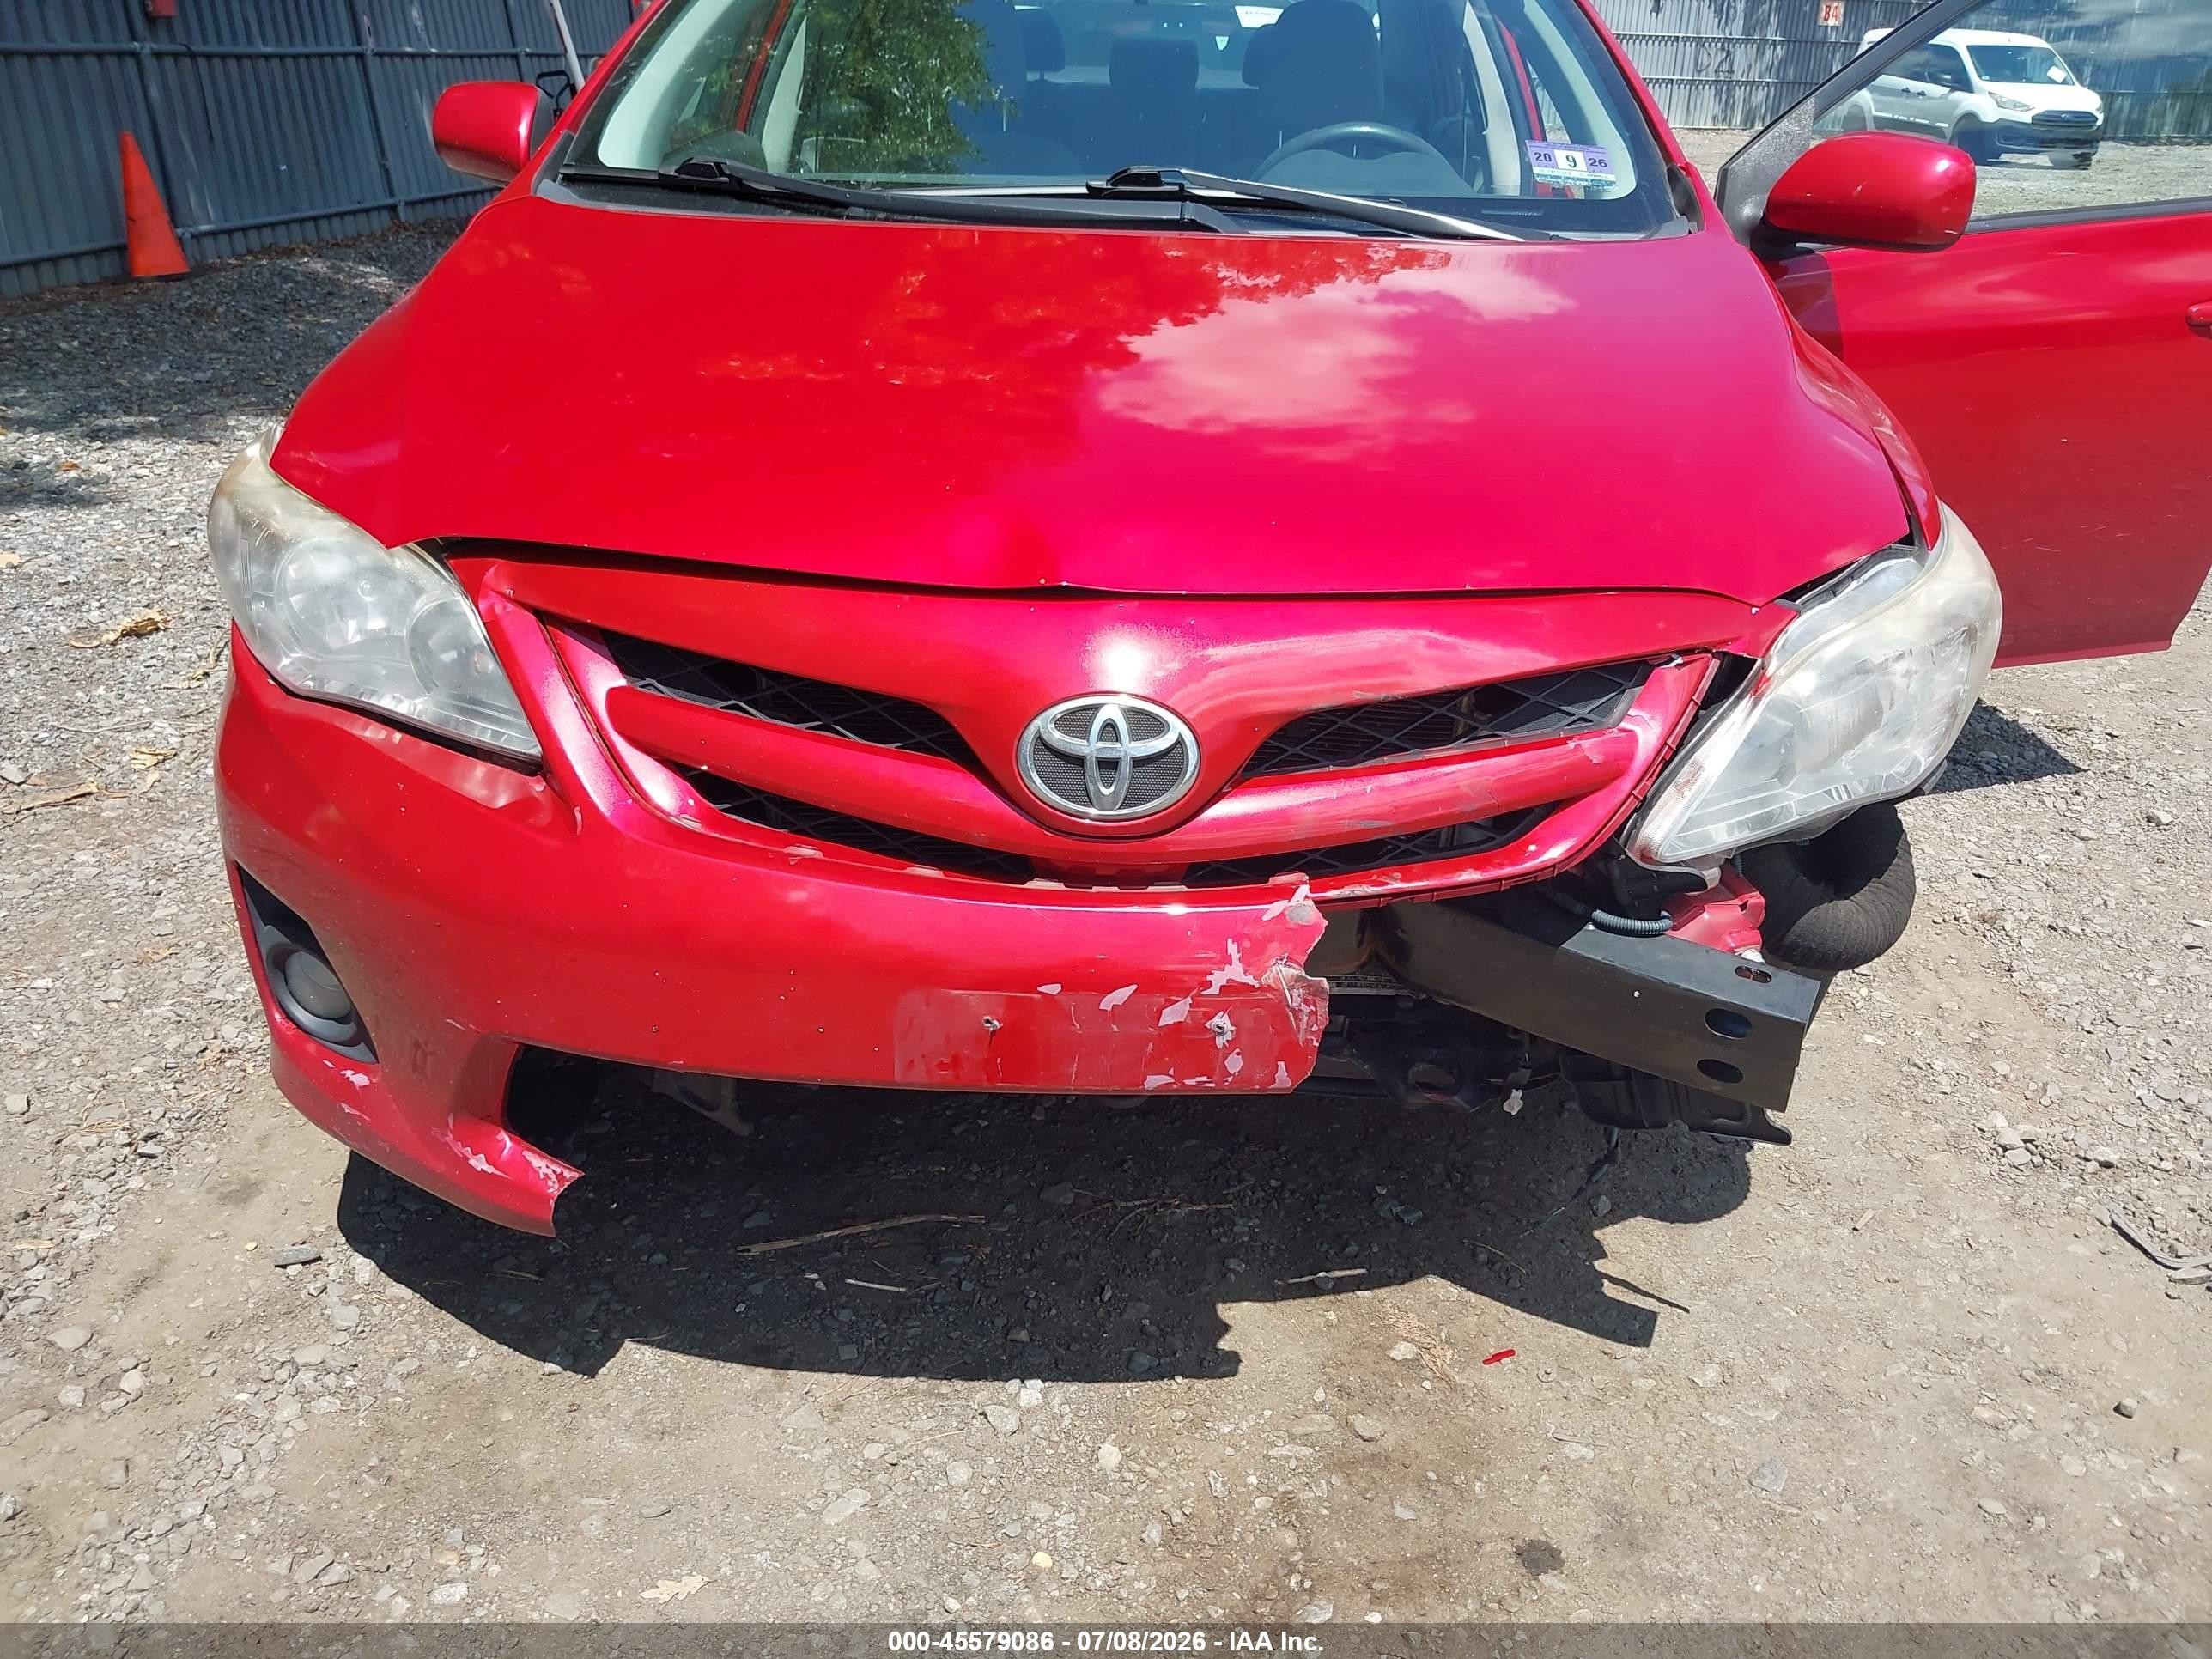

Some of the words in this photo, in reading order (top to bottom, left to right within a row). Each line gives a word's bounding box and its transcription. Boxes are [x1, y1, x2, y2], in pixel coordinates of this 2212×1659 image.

[1534, 152, 1552, 162] 20
[1565, 155, 1577, 168] 9
[1588, 157, 1607, 168] 26
